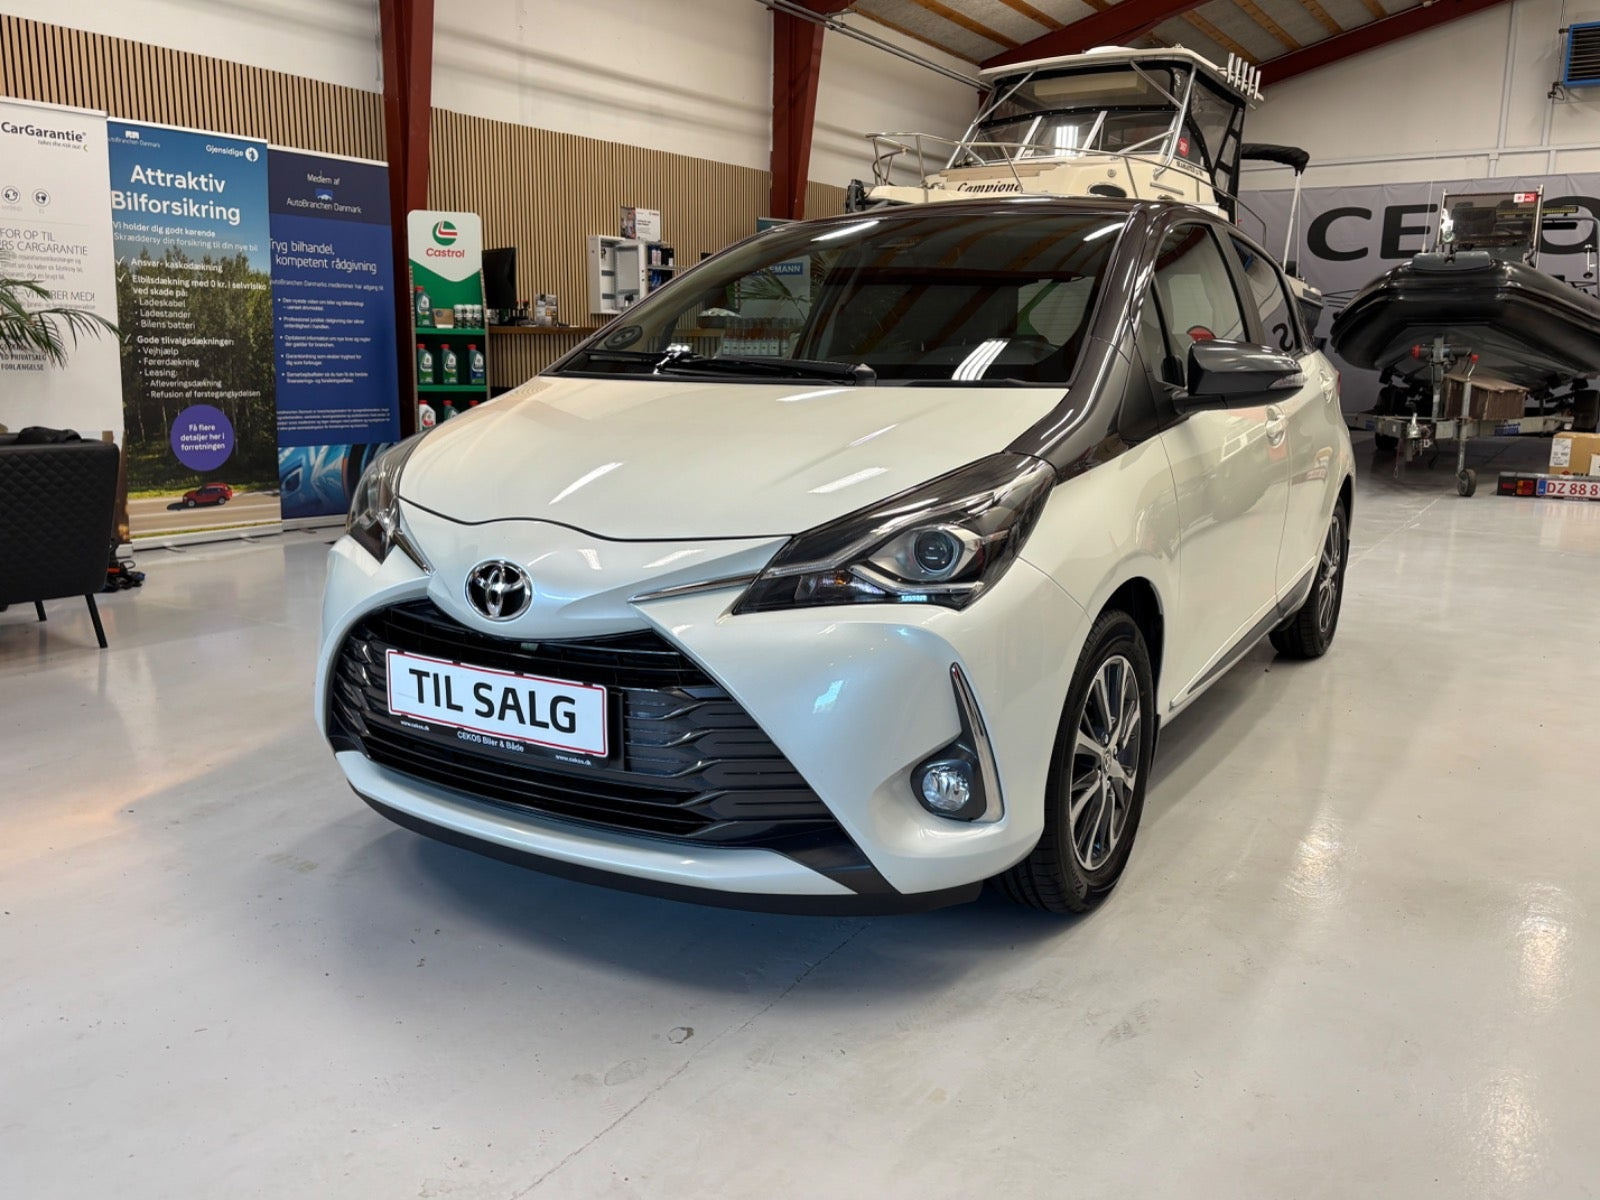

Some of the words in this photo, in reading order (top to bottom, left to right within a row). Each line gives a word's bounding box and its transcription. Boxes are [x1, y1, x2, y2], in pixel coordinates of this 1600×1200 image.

[206, 144, 243, 157] Gjensidige
[131, 164, 226, 192] Attraktiv
[307, 173, 332, 185] Medlem
[334, 177, 340, 186] af
[111, 191, 241, 226] Bilforsikring
[287, 197, 333, 211] AutoBranchen
[334, 203, 362, 214] Danmark
[112, 221, 121, 229] Vi
[123, 222, 149, 232] holder
[151, 225, 163, 235] dig
[165, 226, 183, 236] godt
[24, 230, 38, 240] OP
[41, 231, 55, 242] TIL
[114, 232, 160, 245] Skræddersy
[163, 234, 175, 244] din
[177, 237, 211, 250] forsikring
[222, 241, 233, 250] din
[235, 243, 246, 252] nye
[249, 243, 258, 252] bil
[17, 241, 88, 256] CARGARANTIE
[291, 240, 335, 255] bilhandel,
[426, 248, 465, 258] Castrol
[165, 260, 223, 273] kaskodækning
[276, 254, 328, 269] kompetent
[331, 258, 377, 275] rådgivning
[132, 275, 190, 288] Elbilsdækning
[191, 279, 209, 288] med
[211, 280, 215, 288] 0
[217, 280, 227, 288] kr.
[232, 282, 267, 290] selvrisiko
[132, 288, 148, 296] ved
[150, 288, 173, 296] skade
[139, 299, 186, 308] Ladeskabel
[140, 309, 191, 318] Ladestander
[141, 320, 166, 329] Bilens
[168, 321, 195, 330] batteri
[137, 336, 159, 344] Gode
[143, 347, 179, 357] Vejhjælp
[143, 358, 200, 368] Førerdækning
[150, 380, 222, 389] Afleveringsdækning
[151, 390, 184, 398] Refusion
[180, 434, 208, 442] detaljer
[181, 443, 225, 451] forretningen
[1547, 482, 1566, 494] DZ
[1570, 483, 1587, 495] 88
[1590, 484, 1600, 496] 8
[409, 668, 463, 712] TIL
[474, 682, 576, 734] SALG
[457, 730, 481, 744] CEKOS
[482, 736, 498, 747] Biler
[500, 740, 505, 748] &
[506, 741, 524, 753] Både
